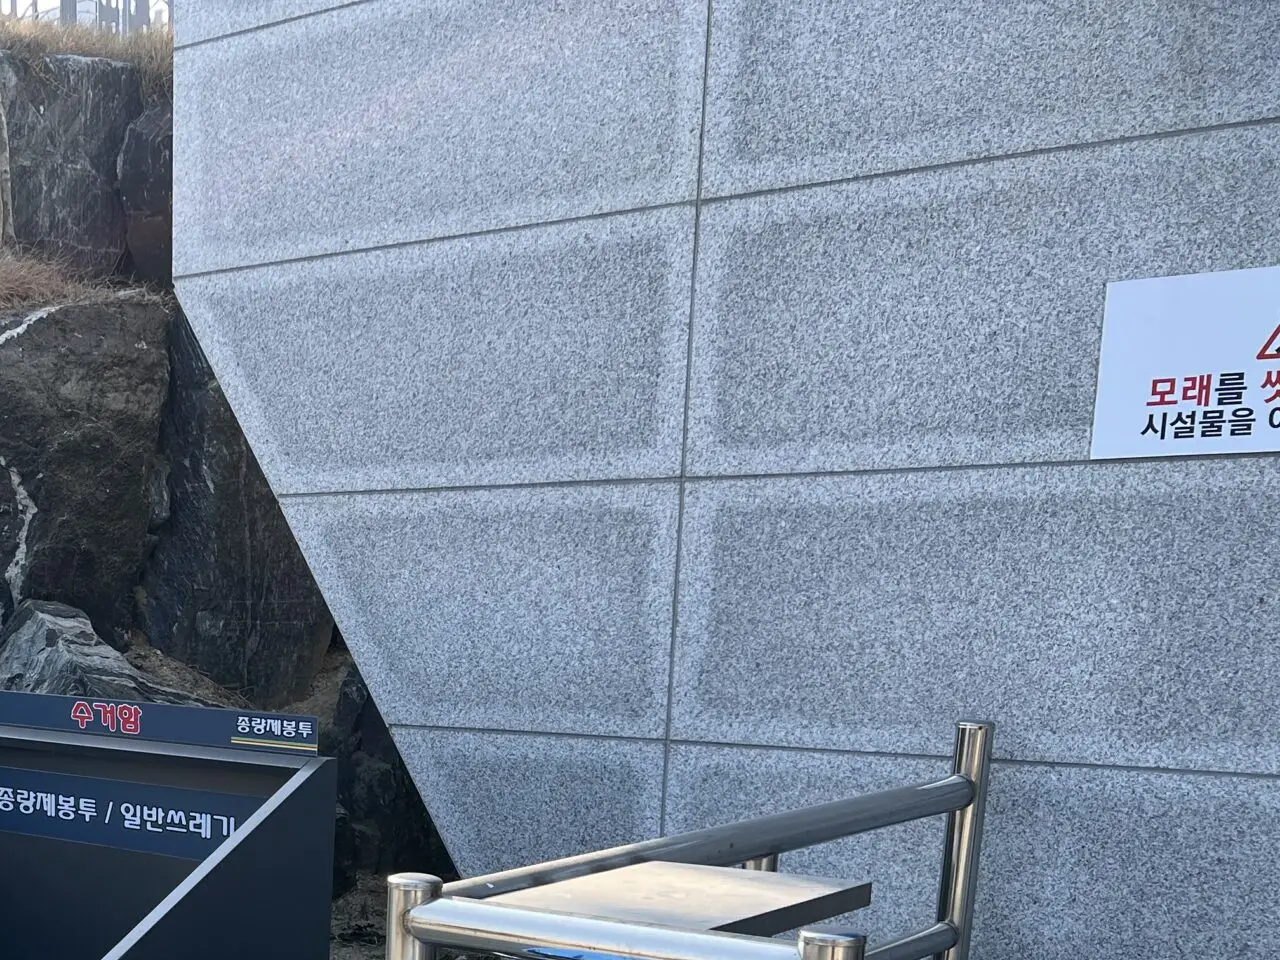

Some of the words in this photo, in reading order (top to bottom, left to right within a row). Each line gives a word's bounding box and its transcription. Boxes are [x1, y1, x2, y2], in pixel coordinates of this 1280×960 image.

[1146, 372, 1247, 407] 모래를
[1140, 407, 1256, 440] 시설물을
[70, 701, 143, 735] 수거함
[236, 715, 313, 738] 종량제봉투
[120, 803, 235, 839] 일반쓰레기
